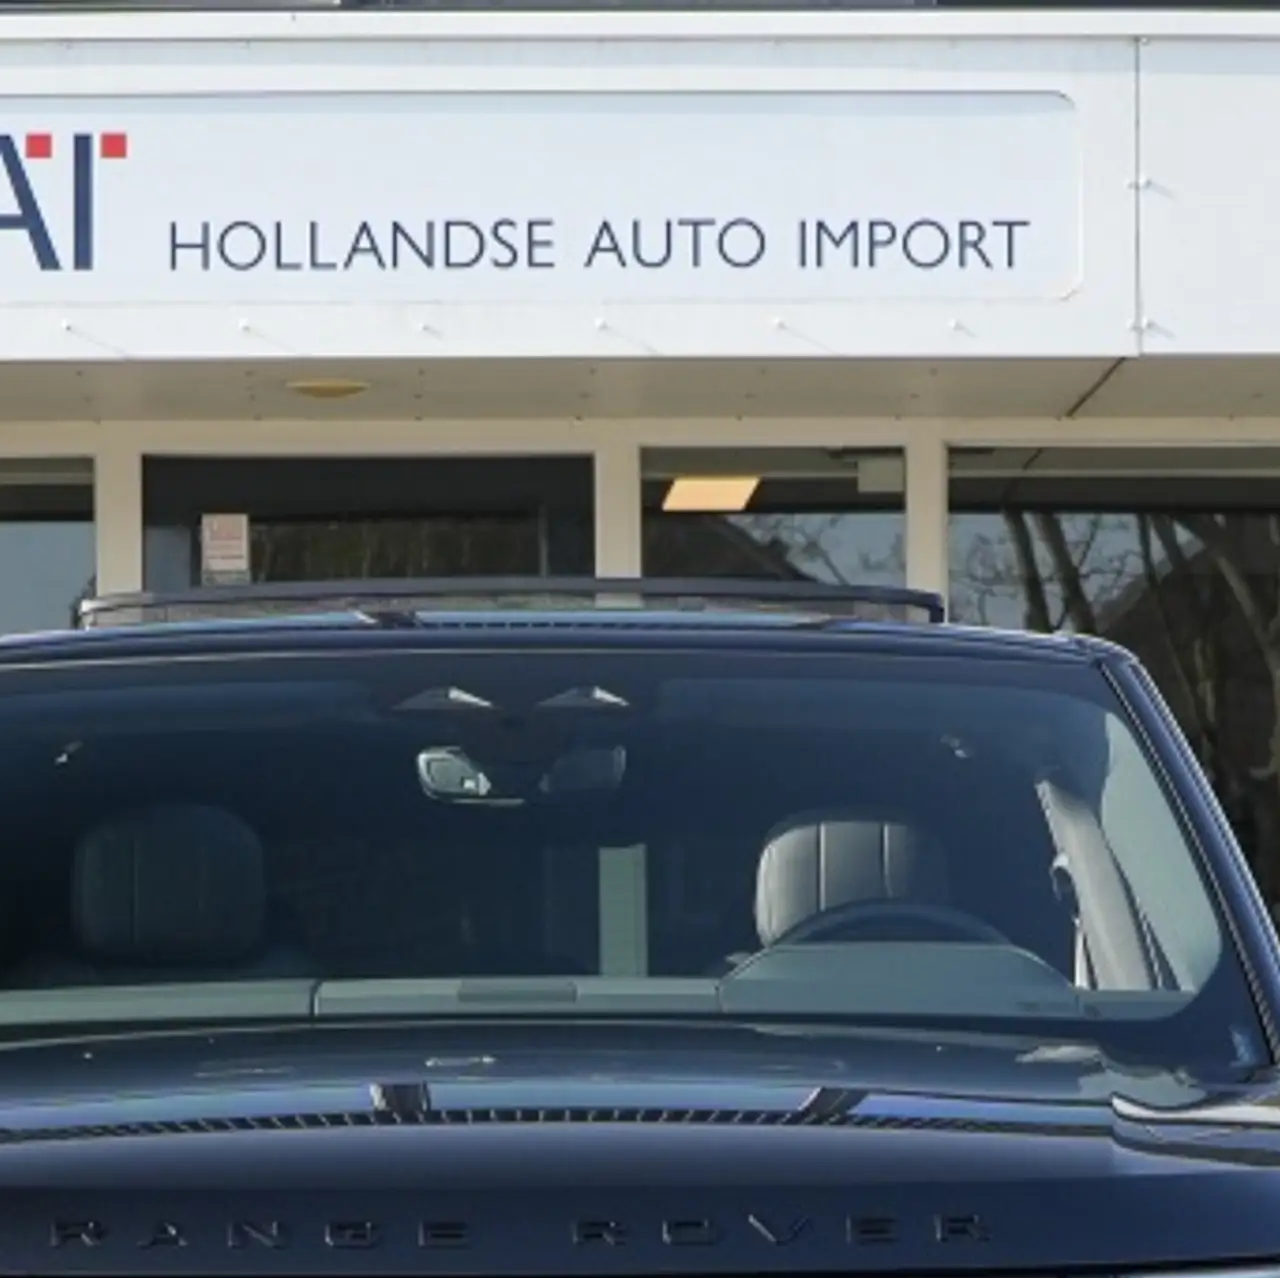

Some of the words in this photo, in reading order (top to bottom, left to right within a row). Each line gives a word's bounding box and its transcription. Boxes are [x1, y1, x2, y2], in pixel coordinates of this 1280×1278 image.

[169, 217, 555, 271] HOLLANDSE
[583, 217, 766, 271] AUTO
[798, 217, 1030, 271] IMPORT
[47, 1218, 476, 1249] RANGE
[568, 1212, 996, 1248] ROVER
